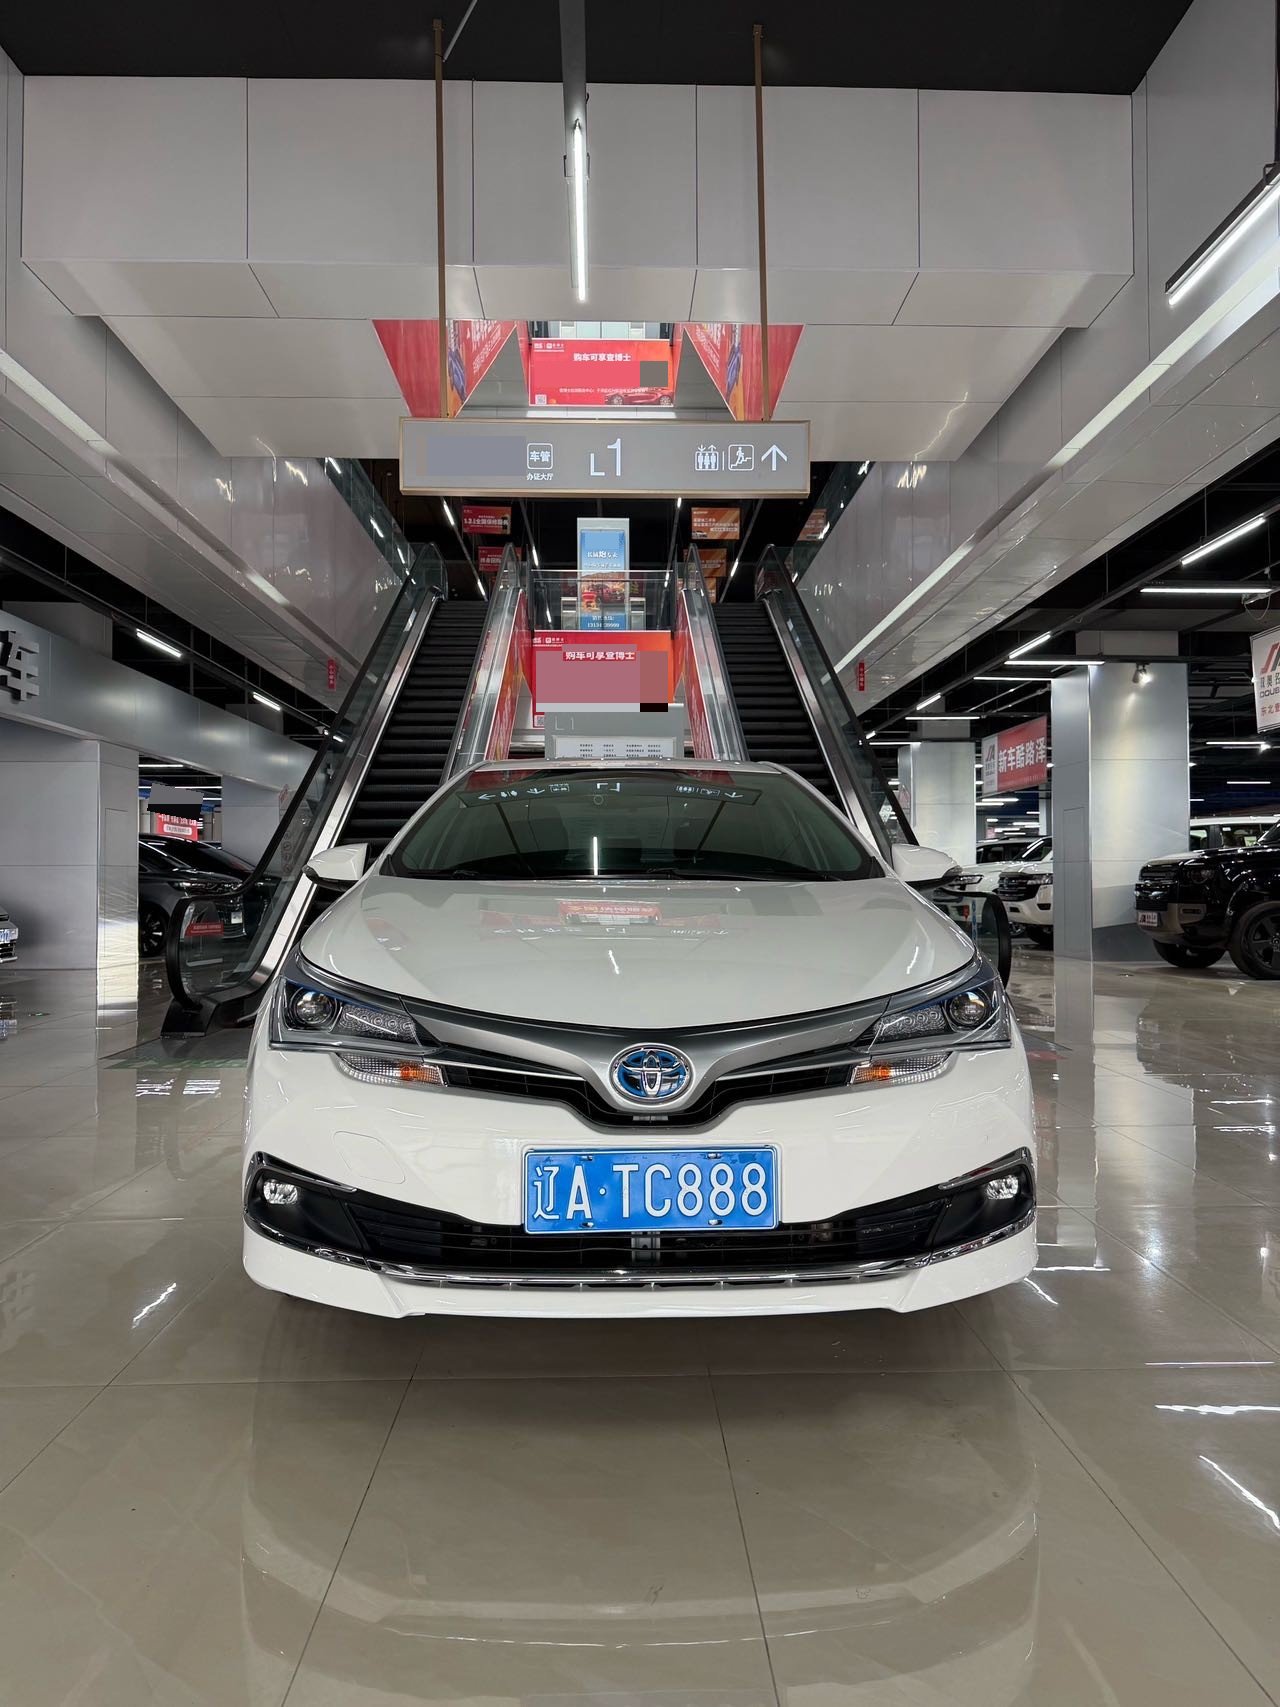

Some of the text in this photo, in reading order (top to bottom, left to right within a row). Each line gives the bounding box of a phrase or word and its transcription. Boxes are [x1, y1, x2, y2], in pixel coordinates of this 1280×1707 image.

[573, 352, 632, 363] 购车可享查博士
[530, 450, 551, 463] 车管
[589, 438, 622, 477] L1
[526, 472, 554, 481] 办证大厅
[998, 736, 1047, 773] 新车酷路泽
